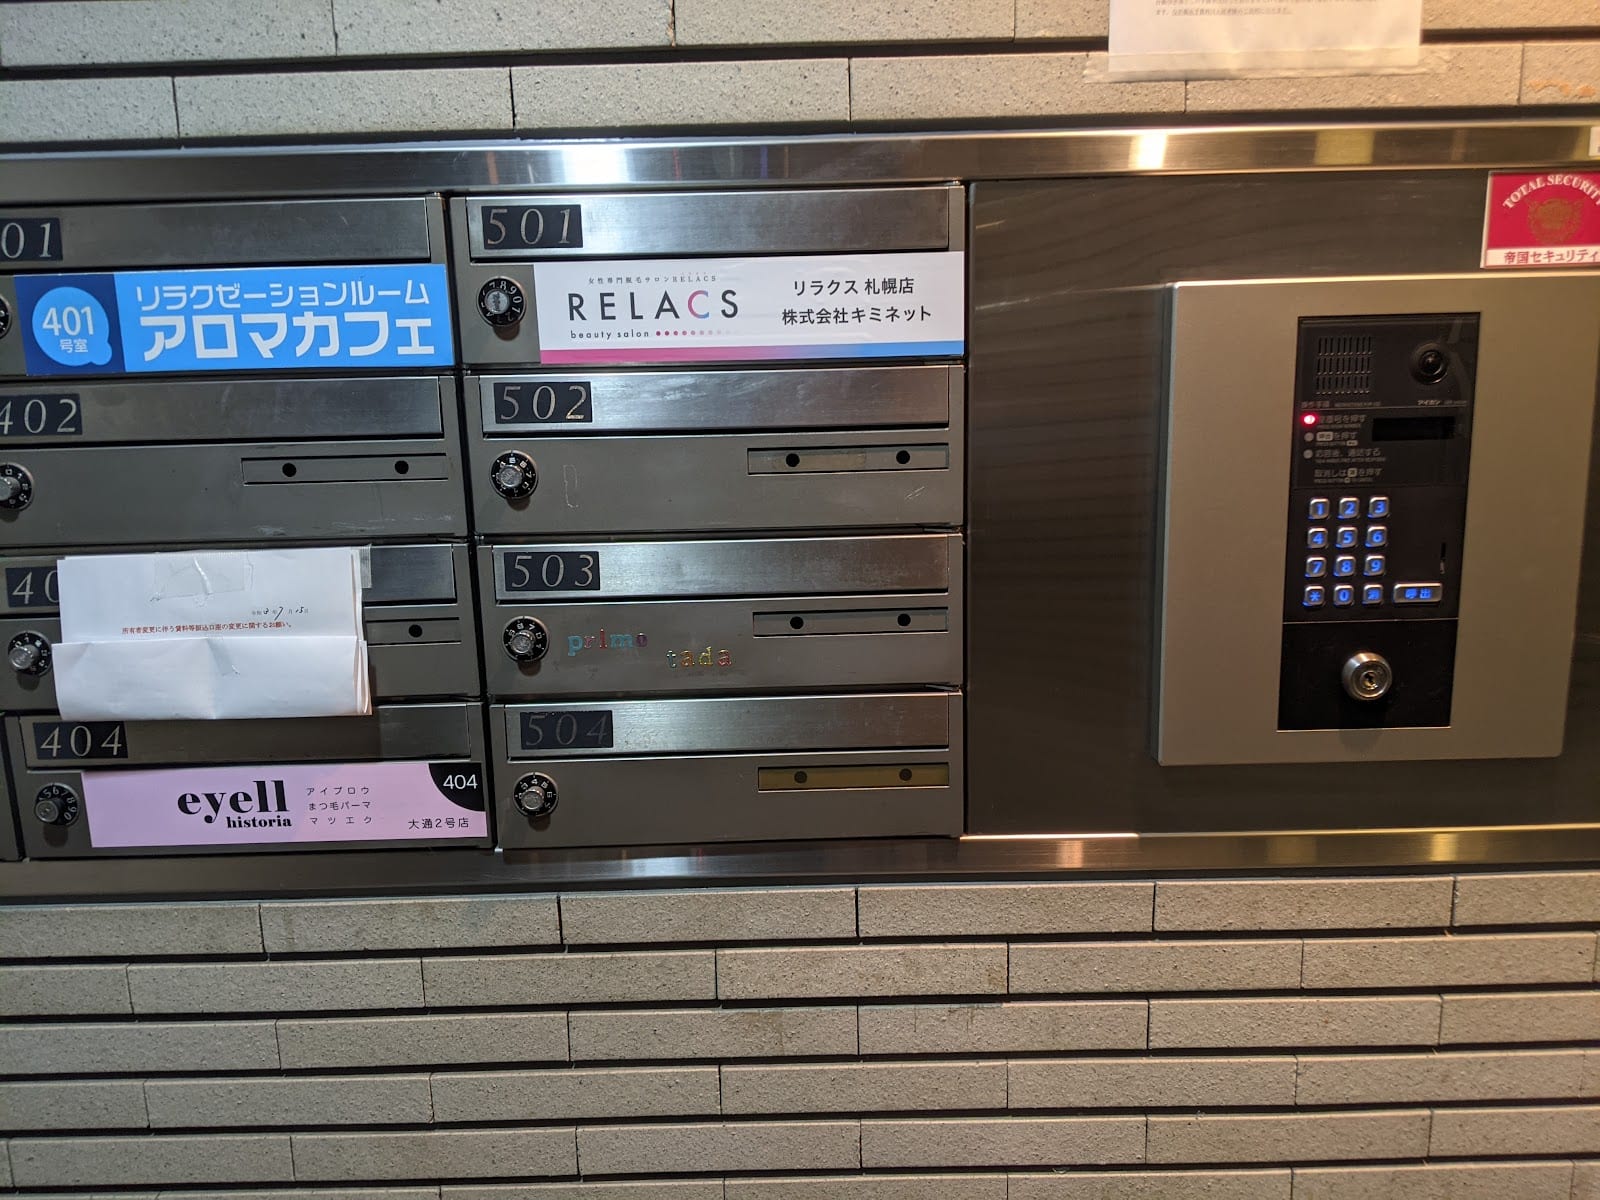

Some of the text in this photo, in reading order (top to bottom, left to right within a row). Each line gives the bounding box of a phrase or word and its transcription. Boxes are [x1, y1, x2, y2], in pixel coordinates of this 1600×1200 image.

[1503, 176, 1545, 209] TOTAL
[487, 207, 572, 247] 501
[0, 222, 53, 259] 01
[1504, 249, 1598, 264] 帝国セキュリティ
[136, 280, 430, 312] リラクゼーションルーム
[793, 276, 914, 296] リラクス 札幌店
[569, 289, 739, 322] RELACS
[781, 304, 932, 326] 株式会社キミネット
[42, 305, 94, 336] 401
[140, 311, 435, 362] アロマカフェ
[570, 328, 649, 340] beauty salon
[60, 338, 88, 353] 号室
[500, 384, 588, 421] 502
[0, 398, 78, 435] 402
[1316, 501, 1385, 516] 1 2 3
[1312, 531, 1383, 545] 4 5 6
[511, 554, 595, 588] 503
[1312, 559, 1382, 574] 7 8 9
[12, 571, 59, 604] 40
[1339, 590, 1350, 602] 0
[666, 647, 732, 668] tada
[525, 713, 607, 746] 504
[40, 725, 123, 758] 404
[443, 774, 478, 790] 404
[177, 780, 289, 823] eyell
[308, 801, 371, 811] まつ毛パーマ
[226, 815, 292, 828] historia
[309, 816, 373, 825] マツエク
[407, 817, 469, 829] 大通2号店
